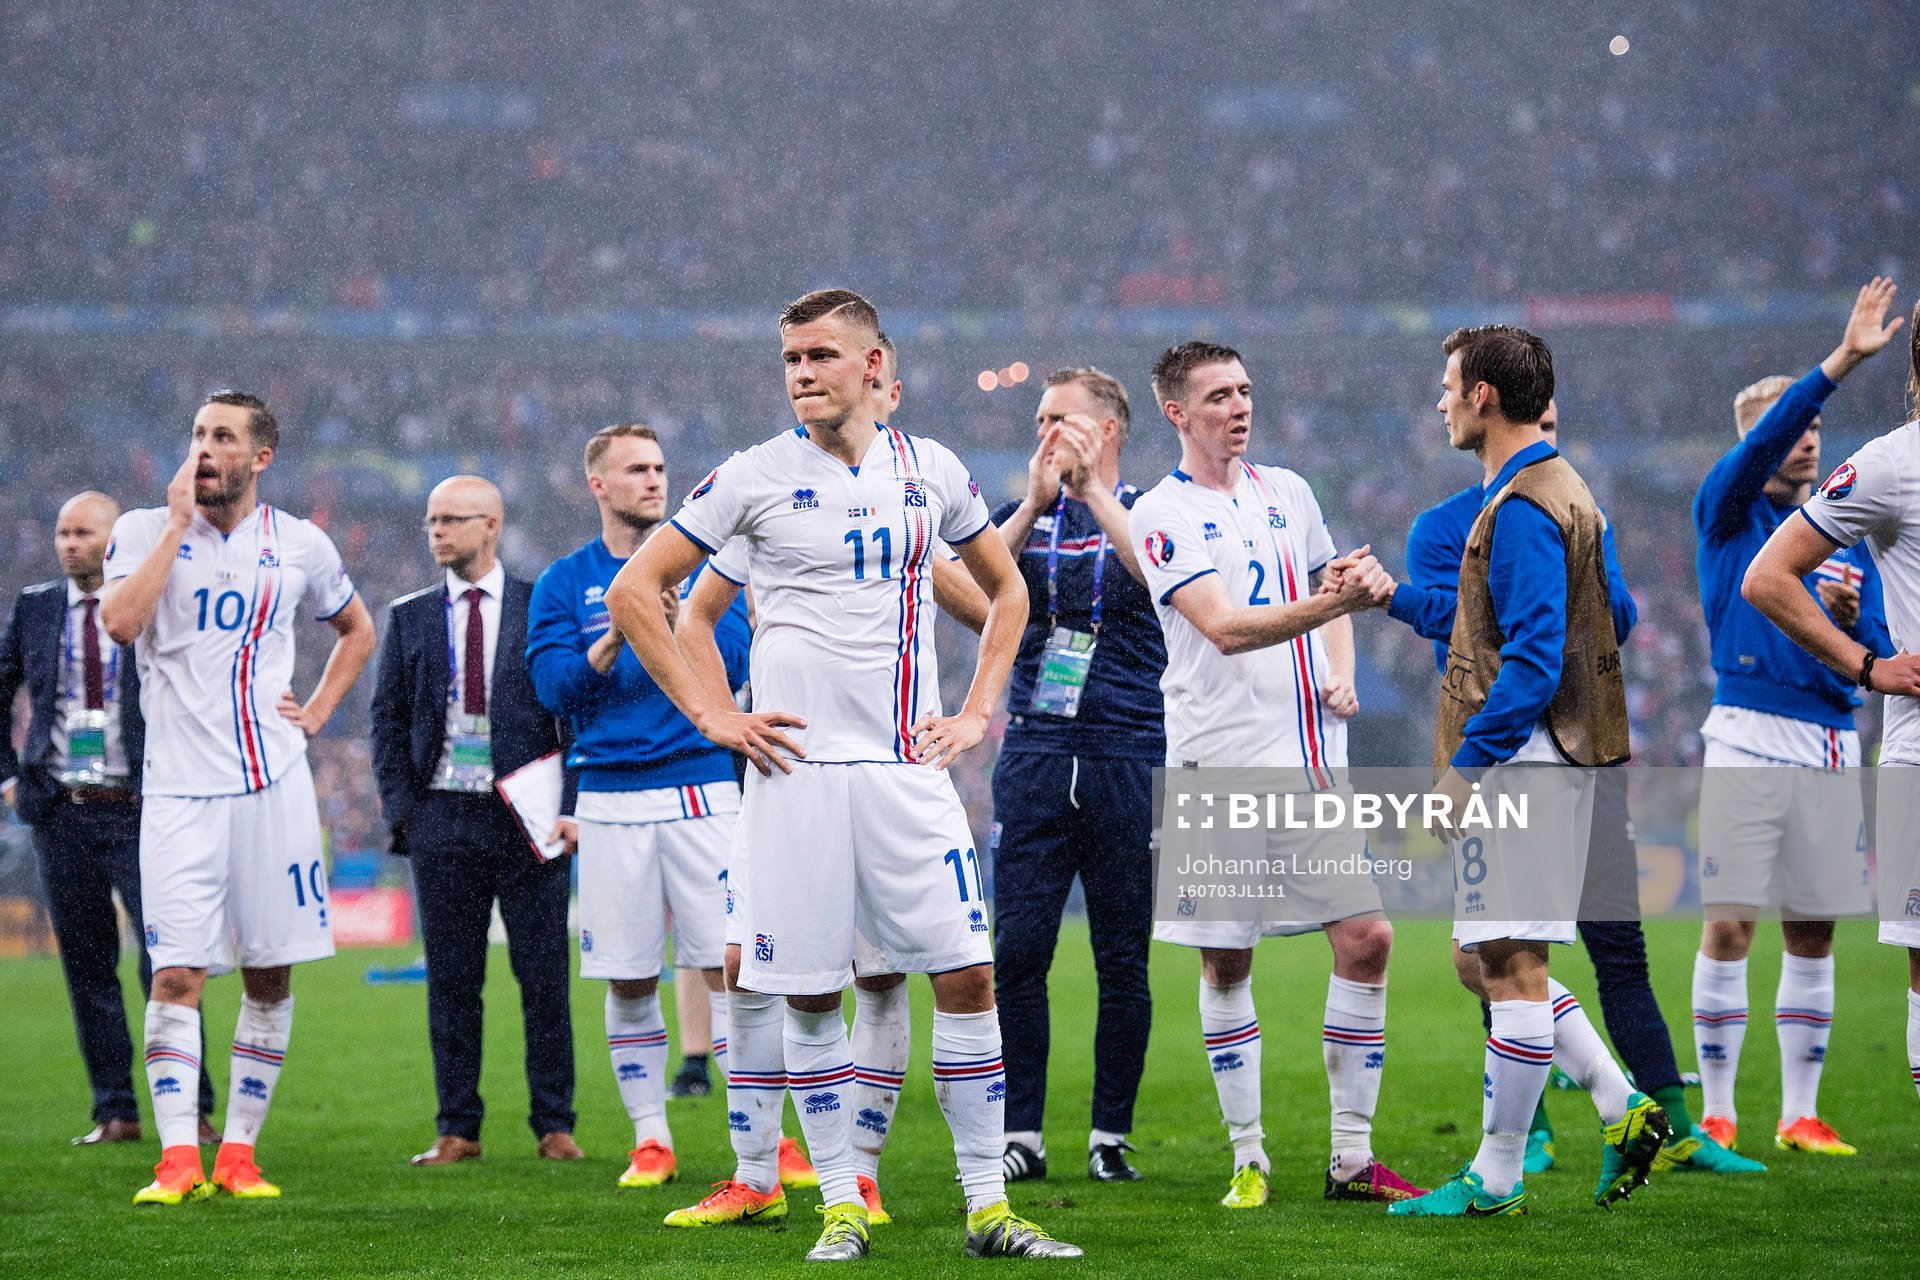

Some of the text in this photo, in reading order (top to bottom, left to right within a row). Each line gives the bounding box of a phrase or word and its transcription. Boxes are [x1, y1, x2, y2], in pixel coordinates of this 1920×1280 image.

[844, 527, 891, 579] 11
[1248, 560, 1270, 606] 2
[193, 588, 245, 631] 10
[288, 860, 323, 906] 10
[944, 848, 982, 902] 11
